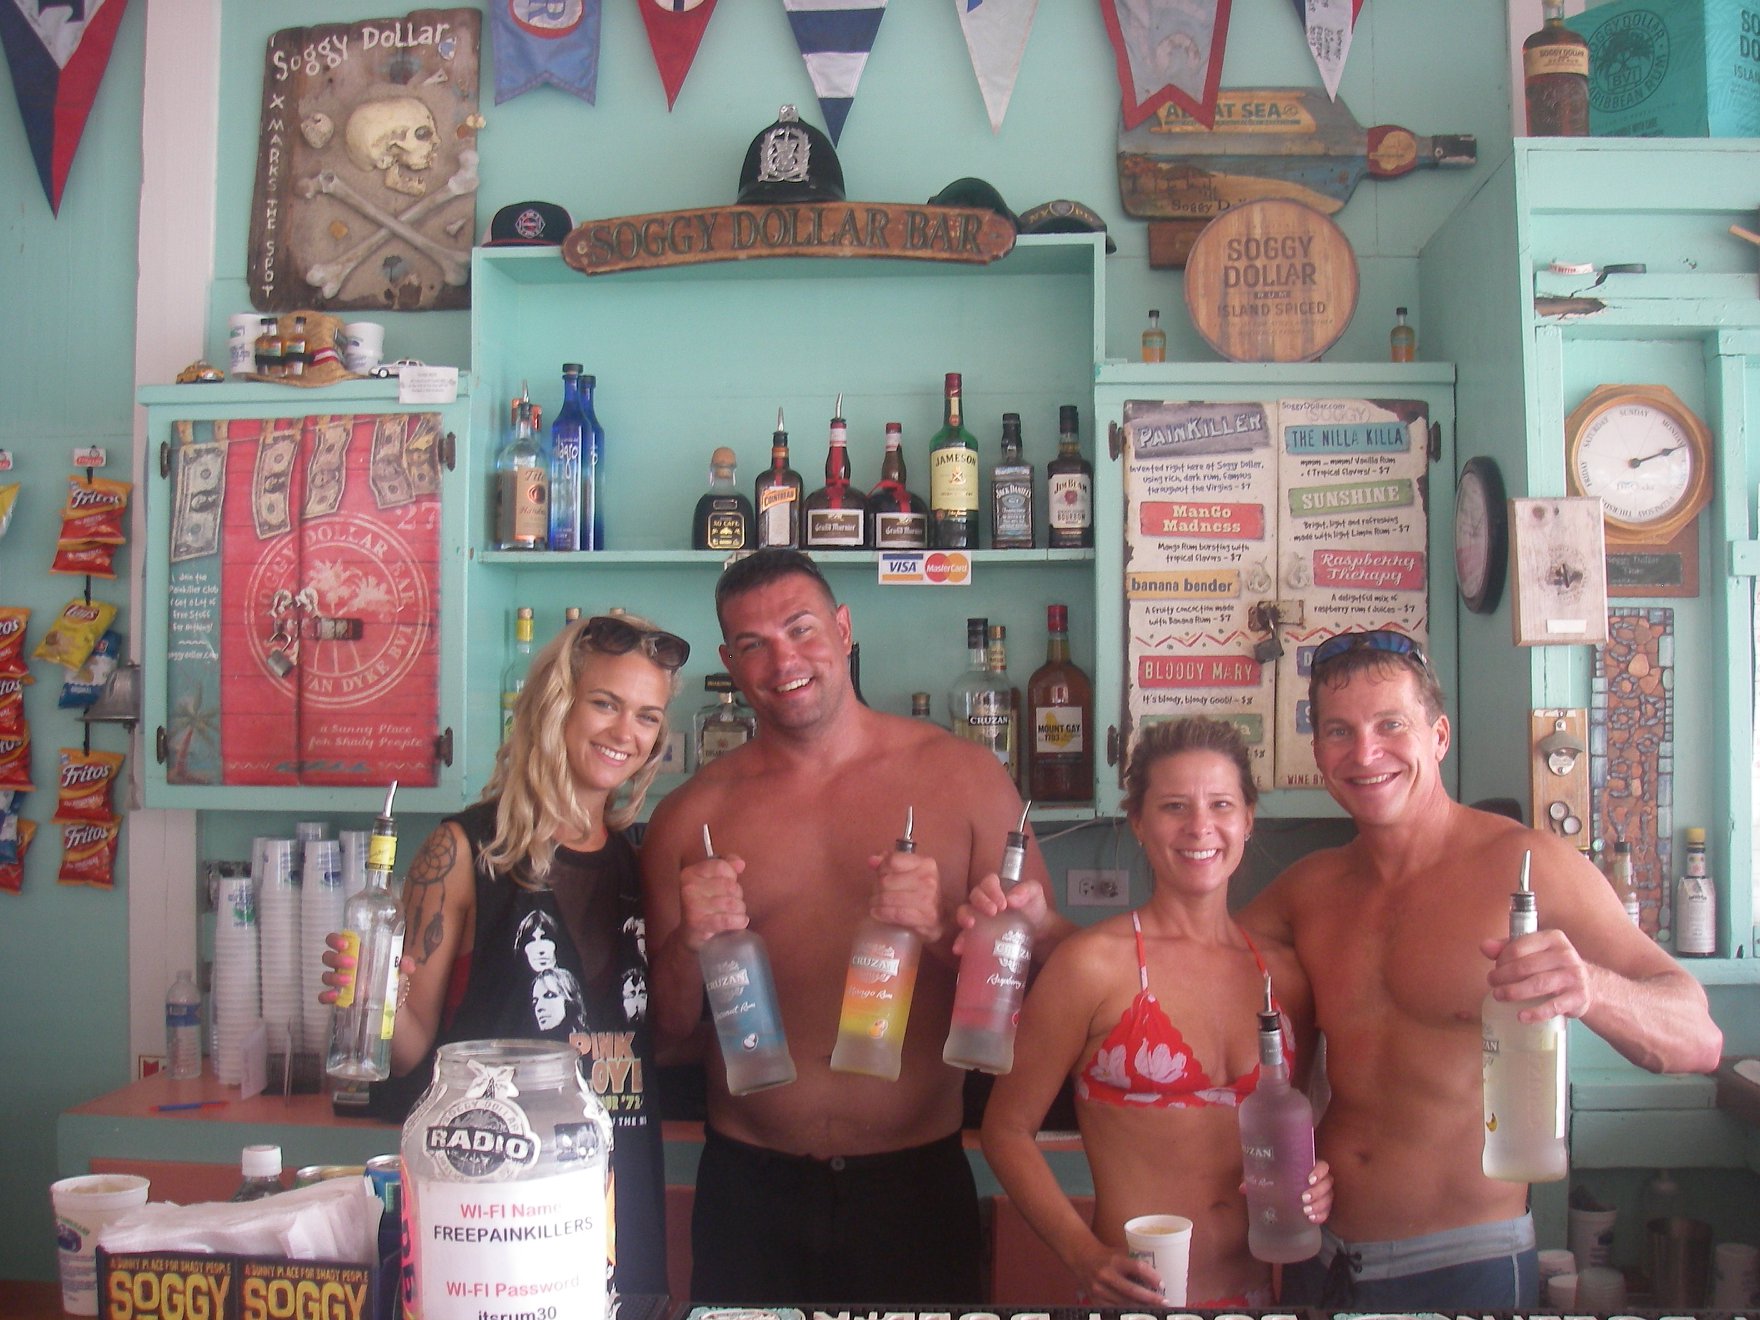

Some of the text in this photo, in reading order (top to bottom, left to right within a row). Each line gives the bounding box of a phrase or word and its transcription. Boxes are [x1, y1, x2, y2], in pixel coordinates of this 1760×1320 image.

[273, 22, 450, 81] Soggy Dollar
[1613, 70, 1637, 87] BVI
[1241, 102, 1282, 118] SEA
[261, 94, 285, 297] X MARKS THE SPOT
[588, 206, 984, 265] SOGGY DOLLAR BAR
[1227, 235, 1314, 261] SOGGY
[1223, 262, 1317, 289] DOLLAR
[1275, 301, 1326, 315] SPICED
[1619, 409, 1650, 417] SUNDAY
[1292, 427, 1403, 448] THE NILLA KILLA
[1583, 417, 1609, 448] SATURDAY
[935, 453, 976, 467] JAMESON
[1166, 464, 1185, 473] right
[1217, 461, 1238, 471] Soggy
[1184, 473, 1201, 481] dark
[1312, 467, 1340, 477] Tropical
[1191, 484, 1204, 494] the
[1206, 484, 1233, 494] Virgins
[1302, 485, 1399, 510] SUNSHINE
[396, 502, 441, 529] 27
[1330, 519, 1345, 528] light
[1348, 518, 1360, 526] and
[1163, 519, 1241, 533] Madness
[305, 526, 388, 559] DOLLAR
[889, 561, 968, 573] VISA MasterCard
[1321, 553, 1416, 572] Raspberry
[1131, 578, 1233, 593] banana bender
[1327, 568, 1403, 586] Therapy
[342, 661, 389, 692] DYKE
[1145, 662, 1253, 681] BLOODY MARY
[969, 716, 1008, 725] CRUZAN
[1038, 724, 1081, 734] MOUNT GAY
[332, 724, 373, 736] Sunny
[379, 724, 412, 734] Place
[336, 736, 374, 750] Shady
[379, 736, 422, 750] People
[62, 763, 110, 787] Fritos
[1287, 774, 1309, 785] WINE
[65, 825, 109, 849] Fritos
[569, 1032, 635, 1061] PINK
[619, 1116, 637, 1126] THE
[431, 1128, 530, 1160] RADIO
[461, 1203, 505, 1219] WI-FI
[434, 1217, 593, 1243] FREEPAINKILLERS
[276, 1266, 299, 1278] PLACE
[301, 1267, 314, 1278] FOR
[342, 1269, 368, 1282] PEOPLE
[110, 1270, 231, 1320] SOGGY
[447, 1281, 489, 1297] WI-FI
[244, 1277, 368, 1320] SOGGY
